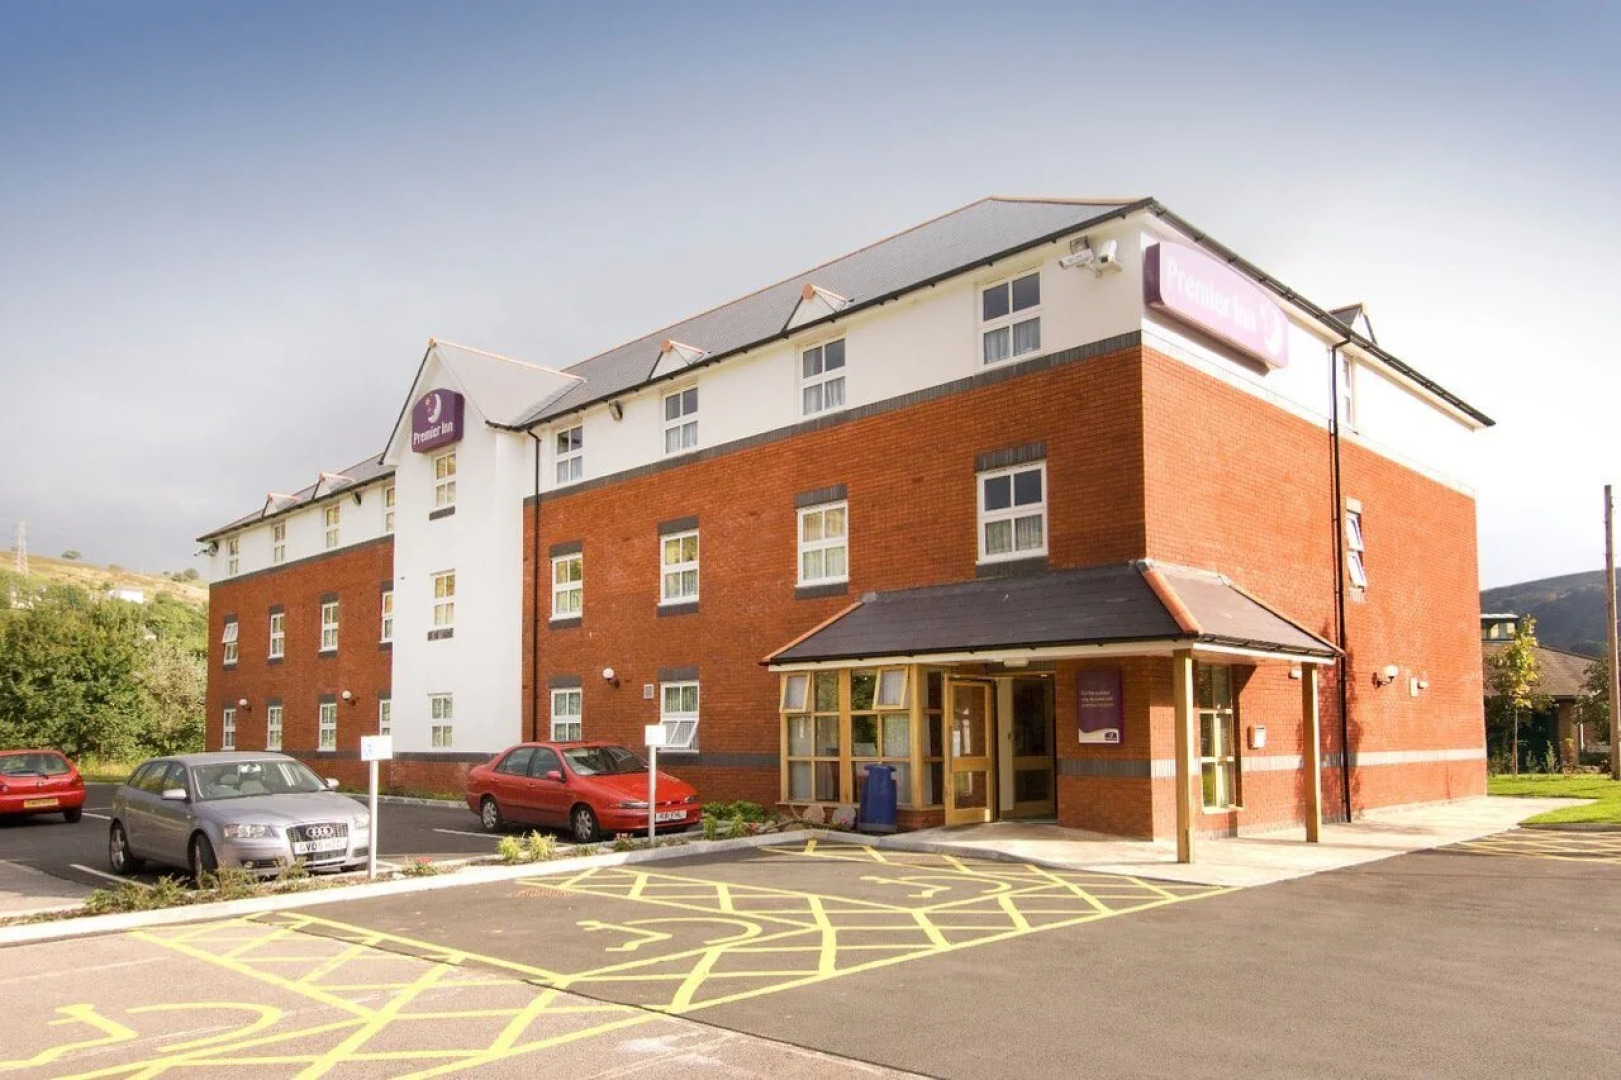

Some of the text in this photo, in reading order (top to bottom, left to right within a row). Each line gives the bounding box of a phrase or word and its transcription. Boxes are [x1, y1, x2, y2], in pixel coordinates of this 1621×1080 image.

[1165, 255, 1257, 334] Premier Inn
[413, 421, 453, 445] Premier Inn
